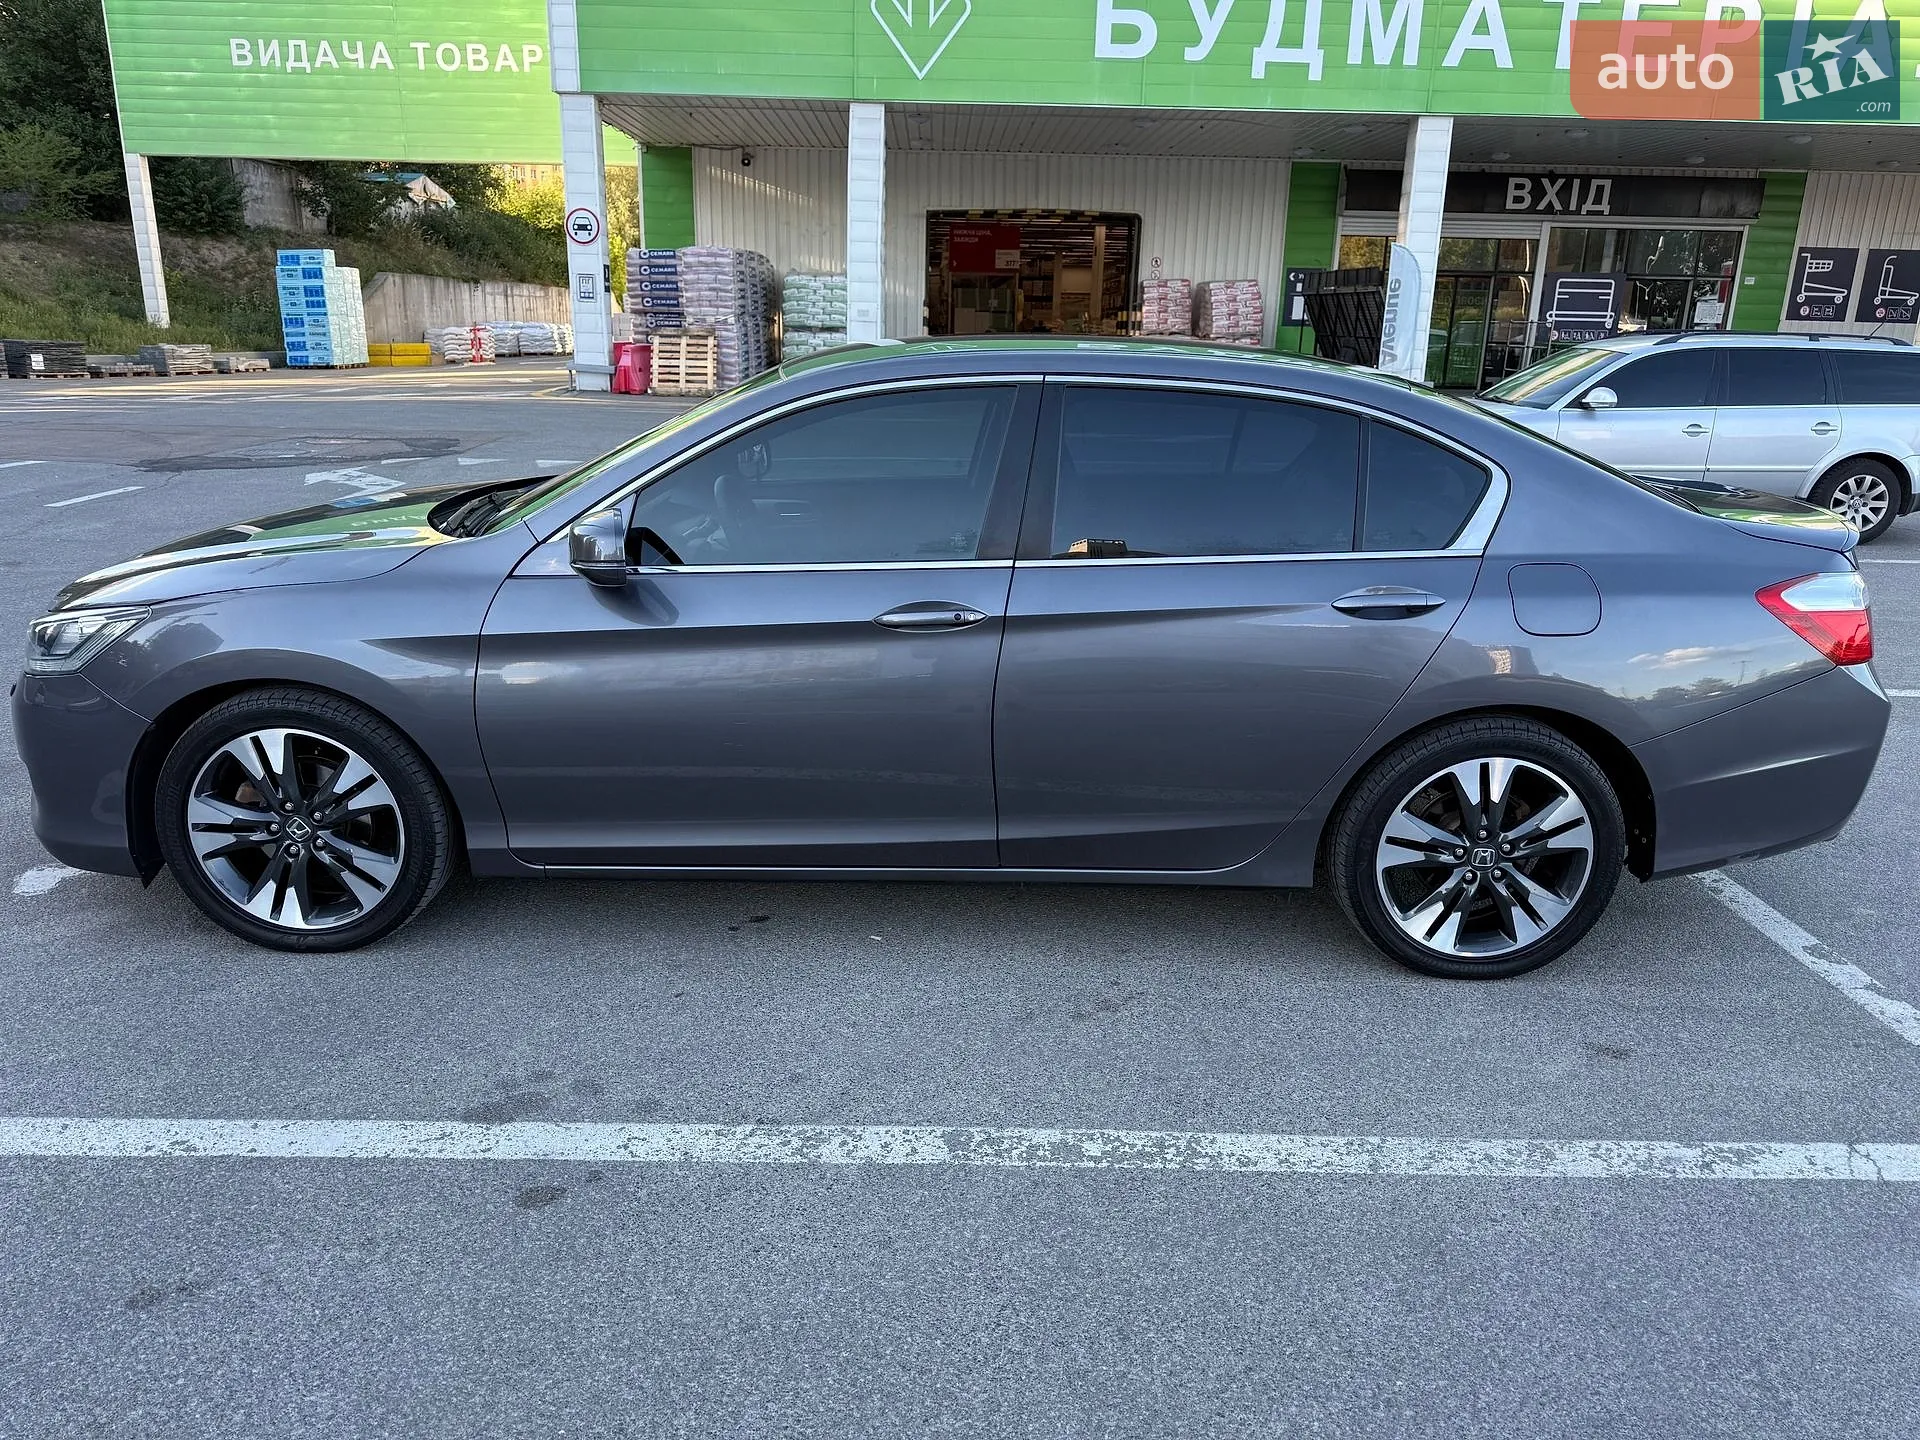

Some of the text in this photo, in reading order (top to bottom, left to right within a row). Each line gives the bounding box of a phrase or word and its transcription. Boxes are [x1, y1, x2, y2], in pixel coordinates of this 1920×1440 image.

[229, 38, 544, 73] ВИДАЧА ТОВАР
[1095, 0, 1920, 81] БУДМАТЕРІА
[1505, 177, 1612, 215] ВХІД
